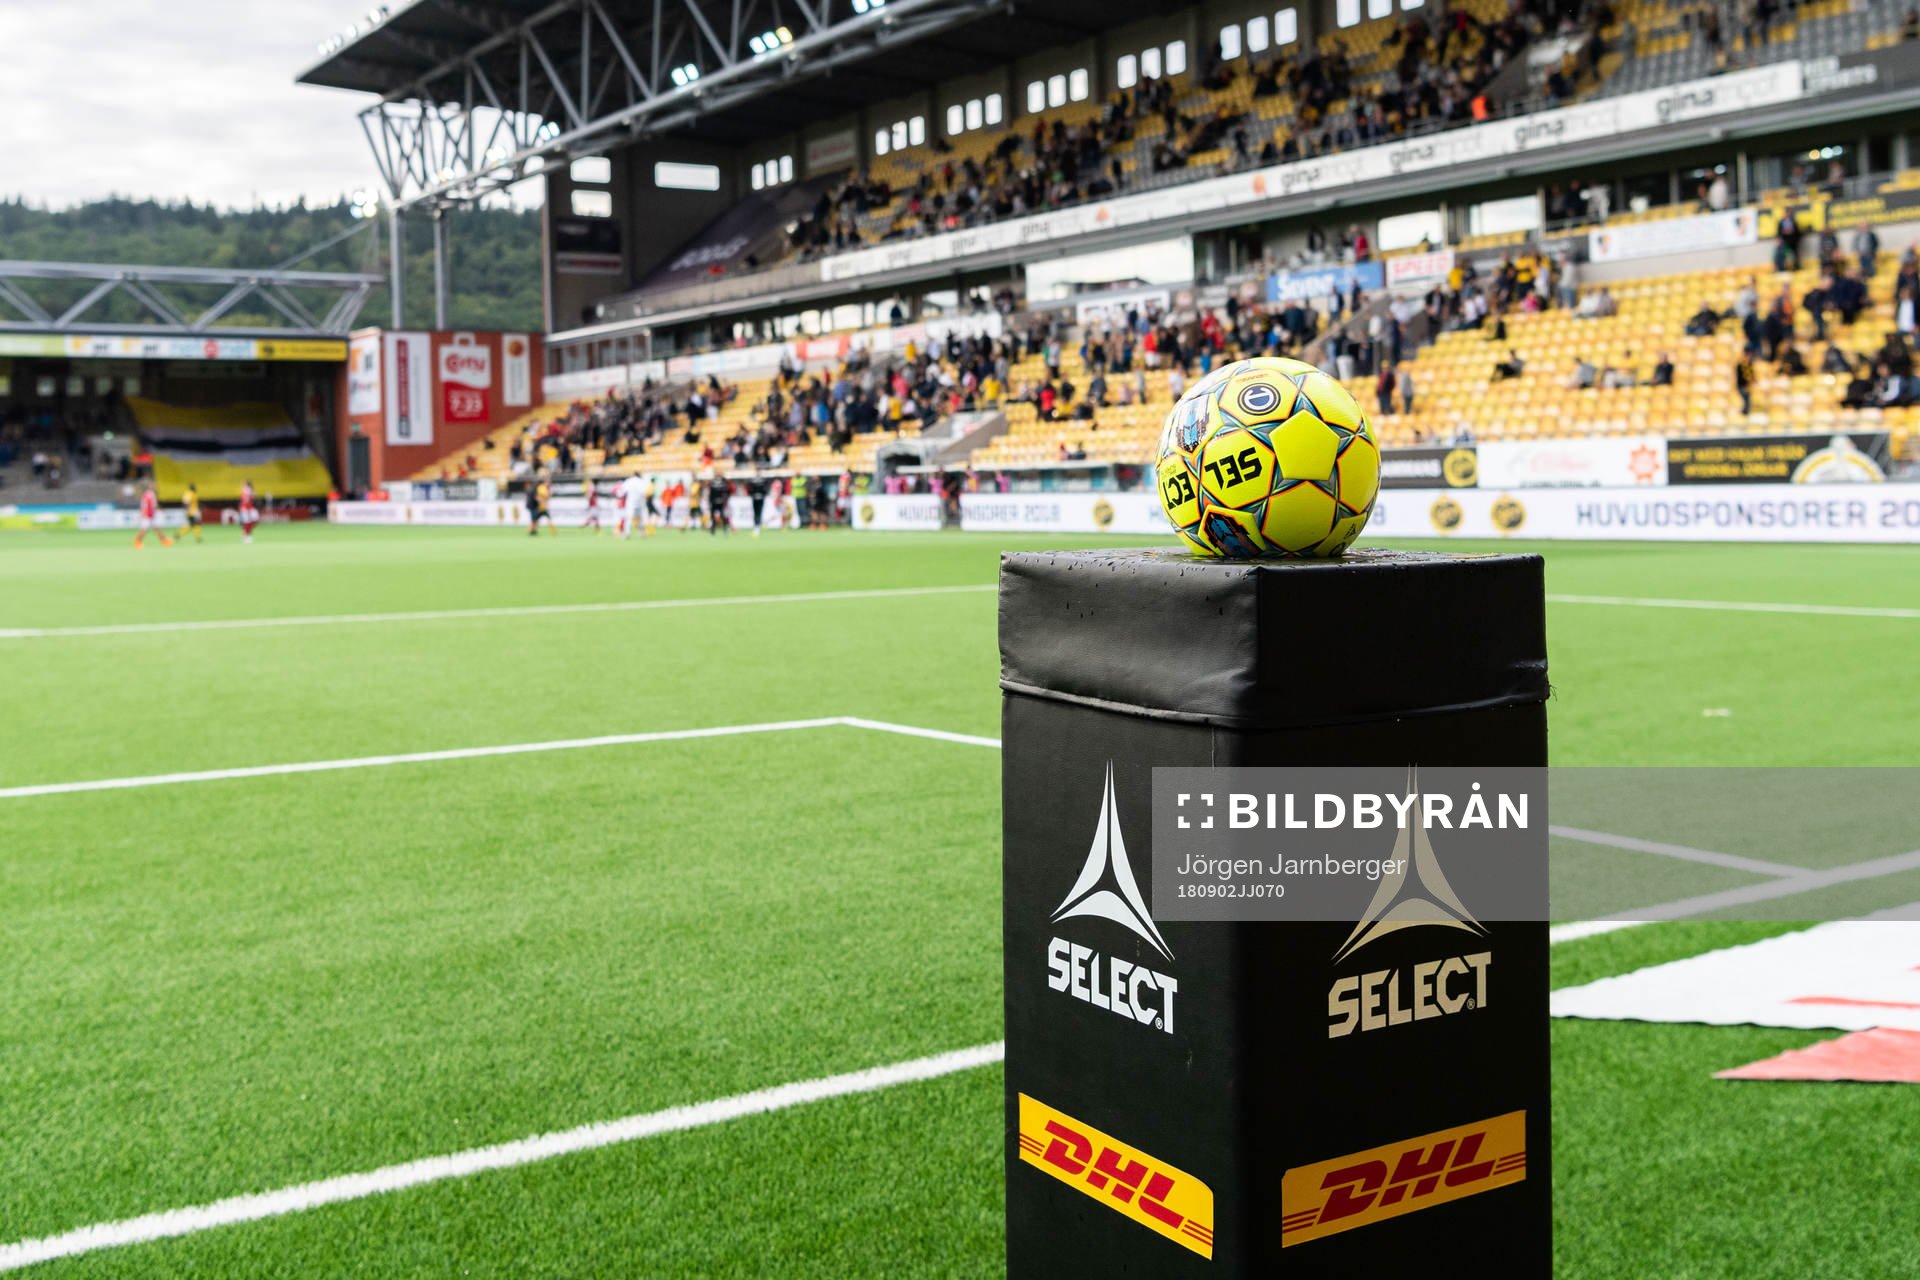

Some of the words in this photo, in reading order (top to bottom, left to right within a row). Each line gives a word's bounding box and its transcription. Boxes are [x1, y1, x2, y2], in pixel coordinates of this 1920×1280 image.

[1577, 501, 1866, 528] HUVUDSPONSORER
[1048, 936, 1178, 1035] SELECT
[1328, 951, 1492, 1039] SELECT
[1043, 1119, 1185, 1230] DHL
[1316, 1131, 1497, 1225] DHL
